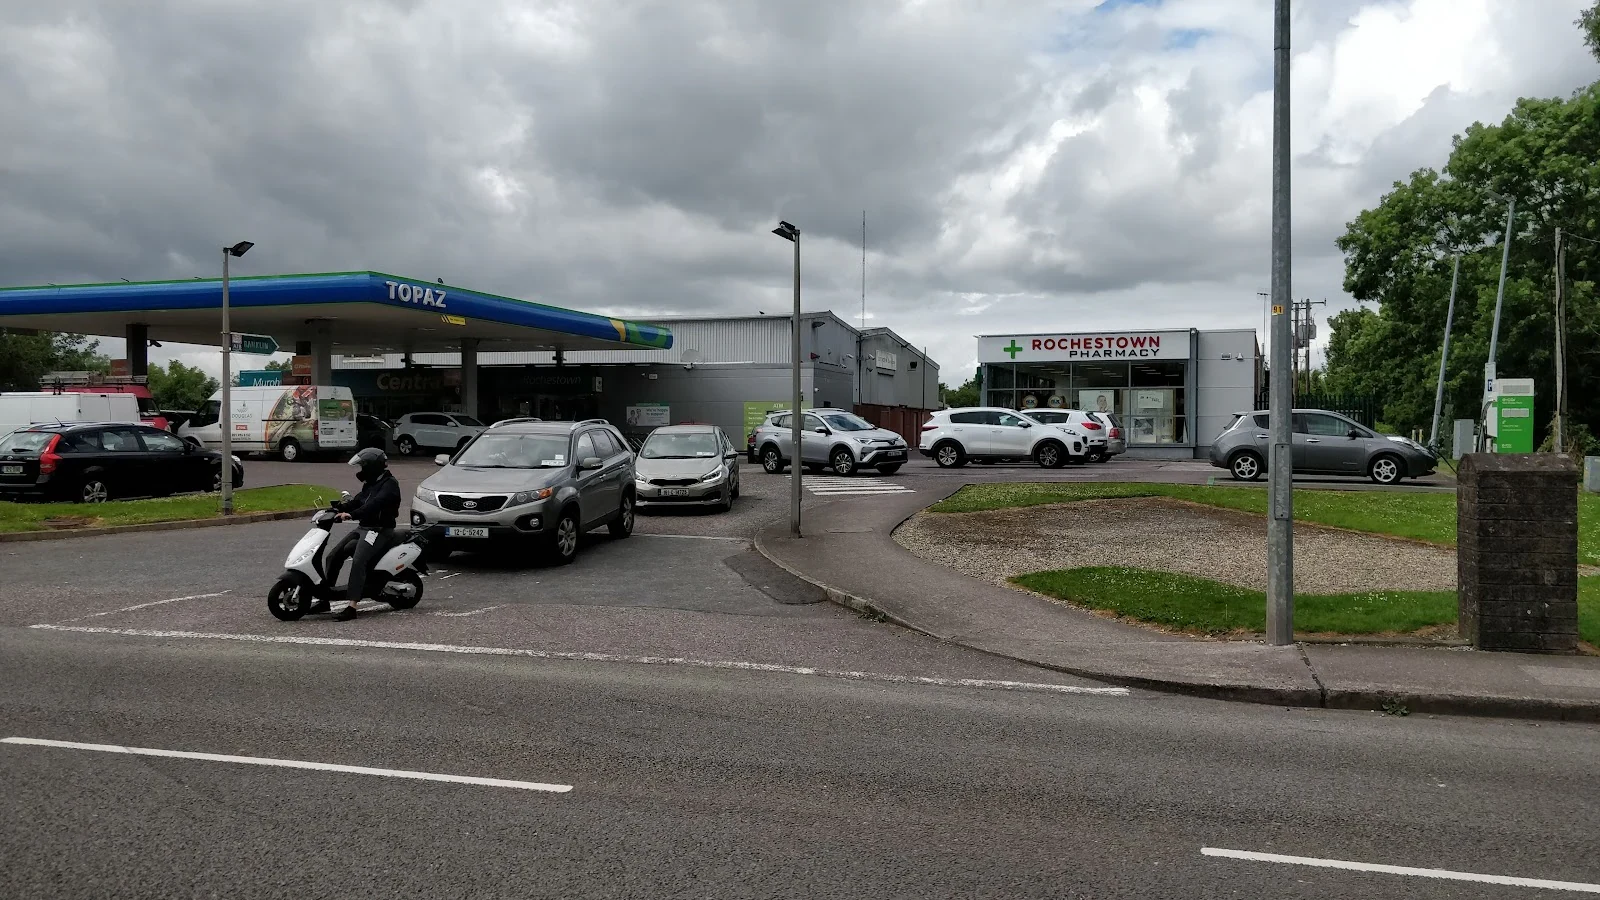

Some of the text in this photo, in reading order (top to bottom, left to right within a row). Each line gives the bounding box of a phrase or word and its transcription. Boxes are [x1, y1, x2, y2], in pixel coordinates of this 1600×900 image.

[385, 280, 447, 308] TOPAZ
[1273, 305, 1282, 313] 91
[1032, 336, 1160, 350] ROCHESTOWN
[1069, 348, 1160, 358] PHARMACY
[376, 372, 444, 390] Centra
[523, 375, 582, 385] Rochestown
